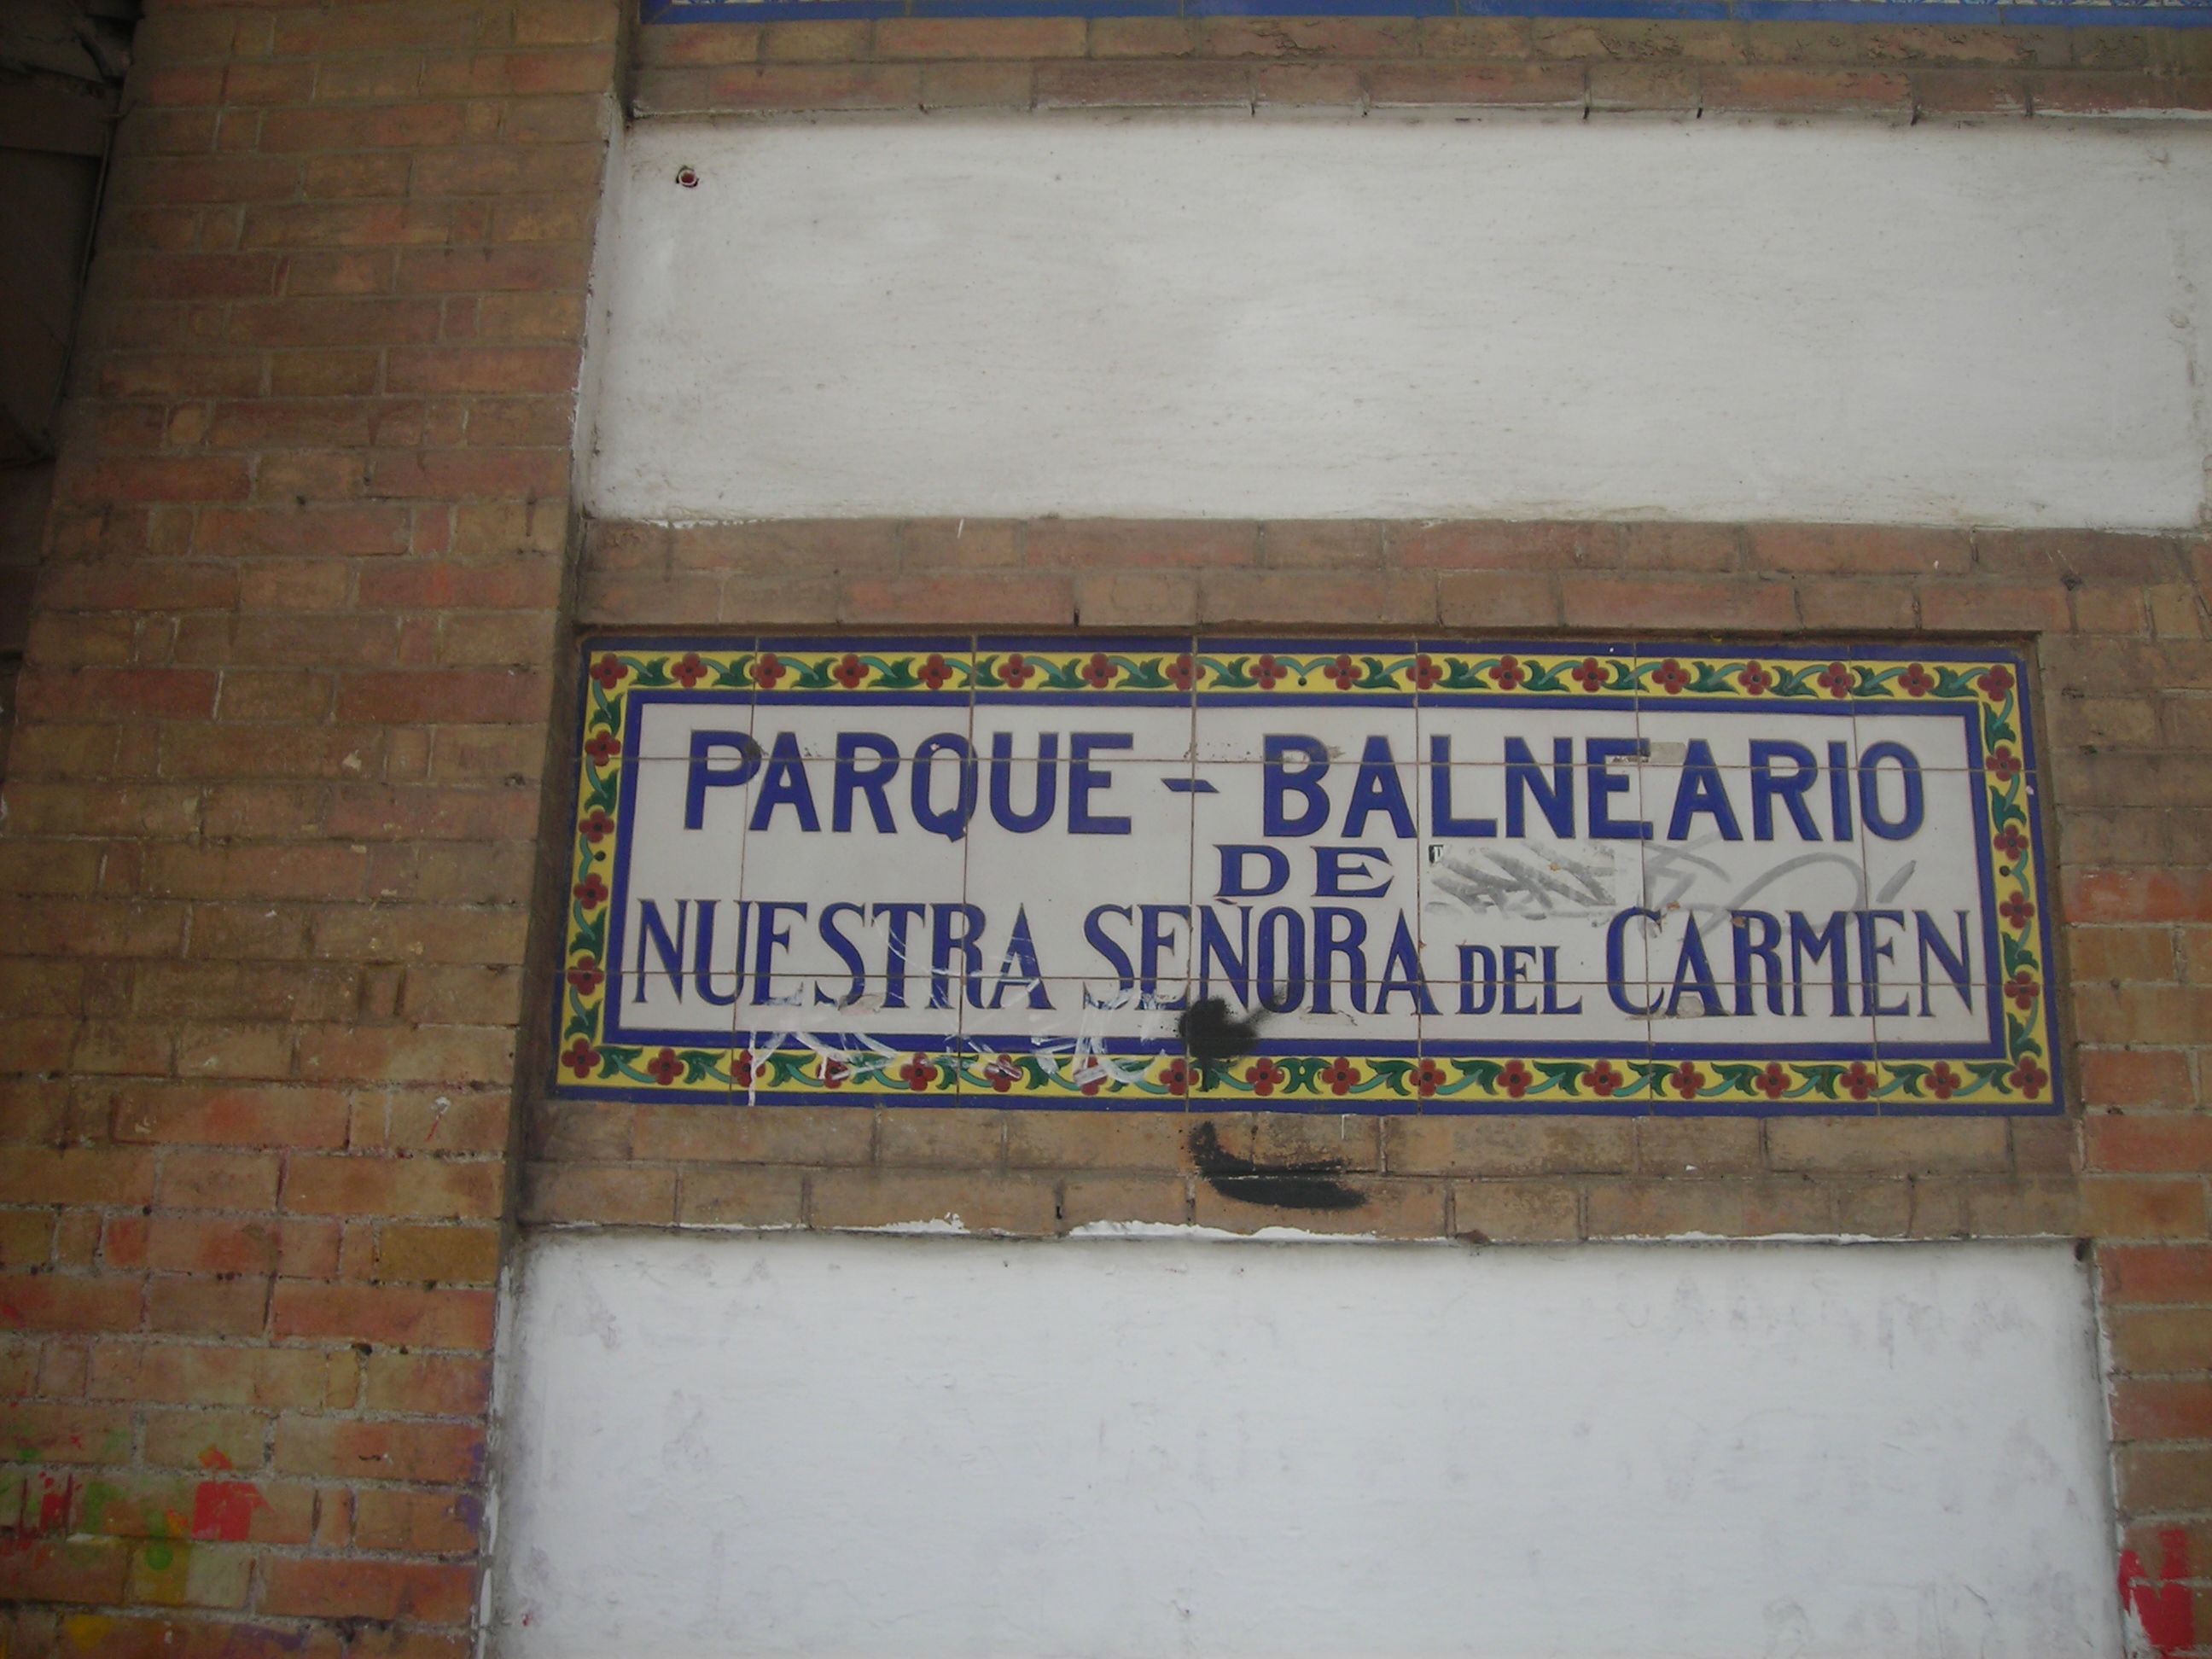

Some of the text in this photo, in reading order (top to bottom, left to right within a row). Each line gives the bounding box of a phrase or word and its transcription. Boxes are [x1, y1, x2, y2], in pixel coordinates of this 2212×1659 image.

[685, 730, 1133, 842] PARQUE
[1262, 733, 1923, 841] BALNEARIO
[1214, 844, 1395, 898] DE
[634, 898, 1976, 1016] NUESTRA SEÑORA DEL CARMEN
